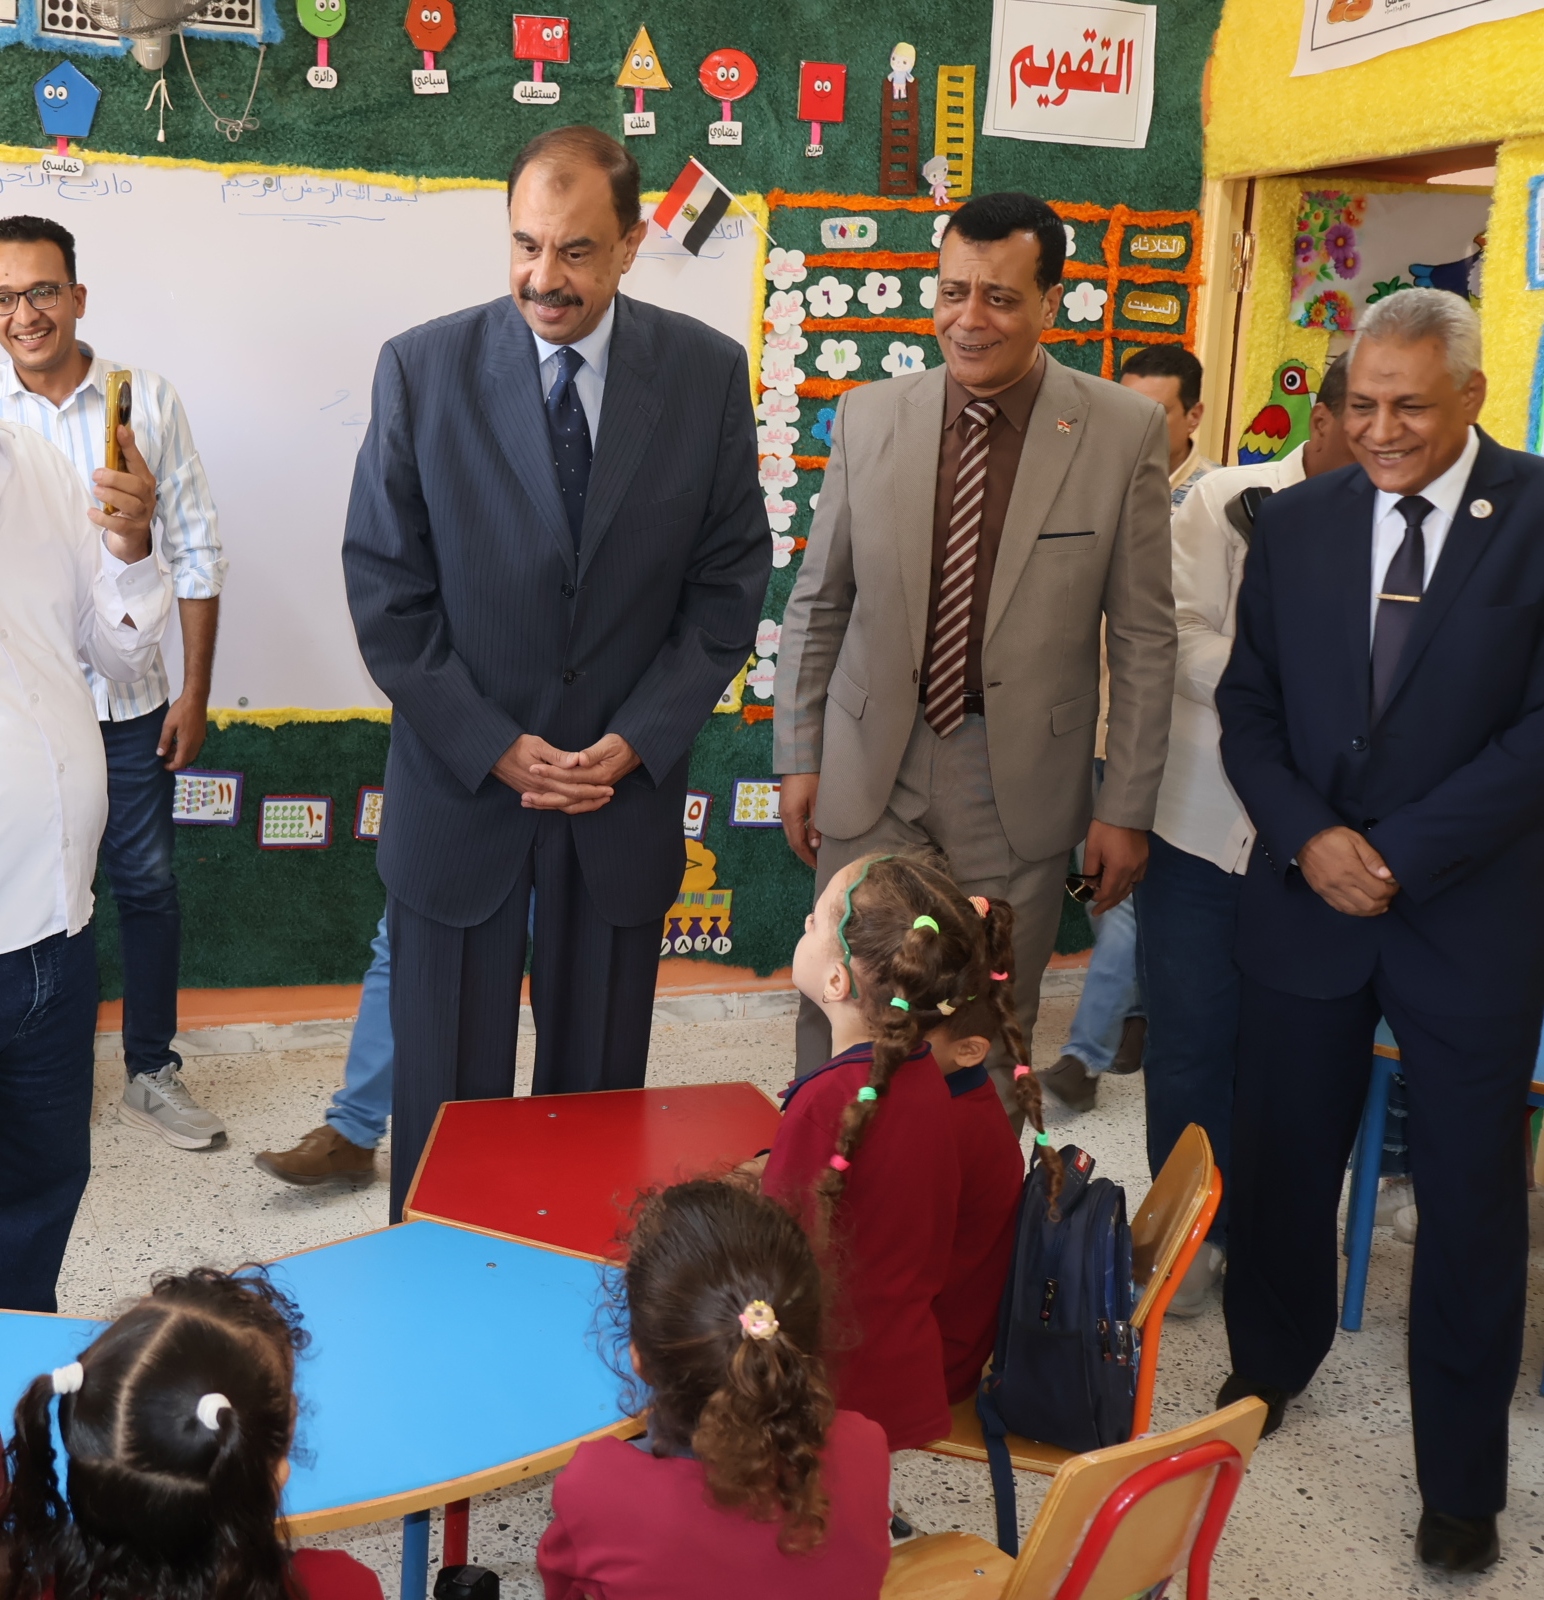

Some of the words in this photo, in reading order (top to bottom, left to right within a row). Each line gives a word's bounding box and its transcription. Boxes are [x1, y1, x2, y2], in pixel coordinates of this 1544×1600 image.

[314, 69, 333, 84] دائرة
[1010, 28, 1134, 110] التقويم
[414, 73, 445, 89] سباعي
[520, 86, 557, 101] مستطيل
[709, 125, 739, 139] بيضاوي
[42, 159, 80, 173] خماسي
[57, 175, 109, 201] ربيع
[282, 180, 343, 204] الرحمن
[346, 184, 370, 202] الله
[374, 193, 418, 206] بسم
[1130, 236, 1181, 253] الثلاثاء
[1128, 298, 1177, 314] السبت
[218, 783, 232, 805] ١١
[306, 804, 323, 828] ١٠
[688, 800, 702, 820] ٥
[305, 830, 323, 838] عشرة
[677, 939, 689, 951] ٨
[719, 939, 728, 951] ١٠
